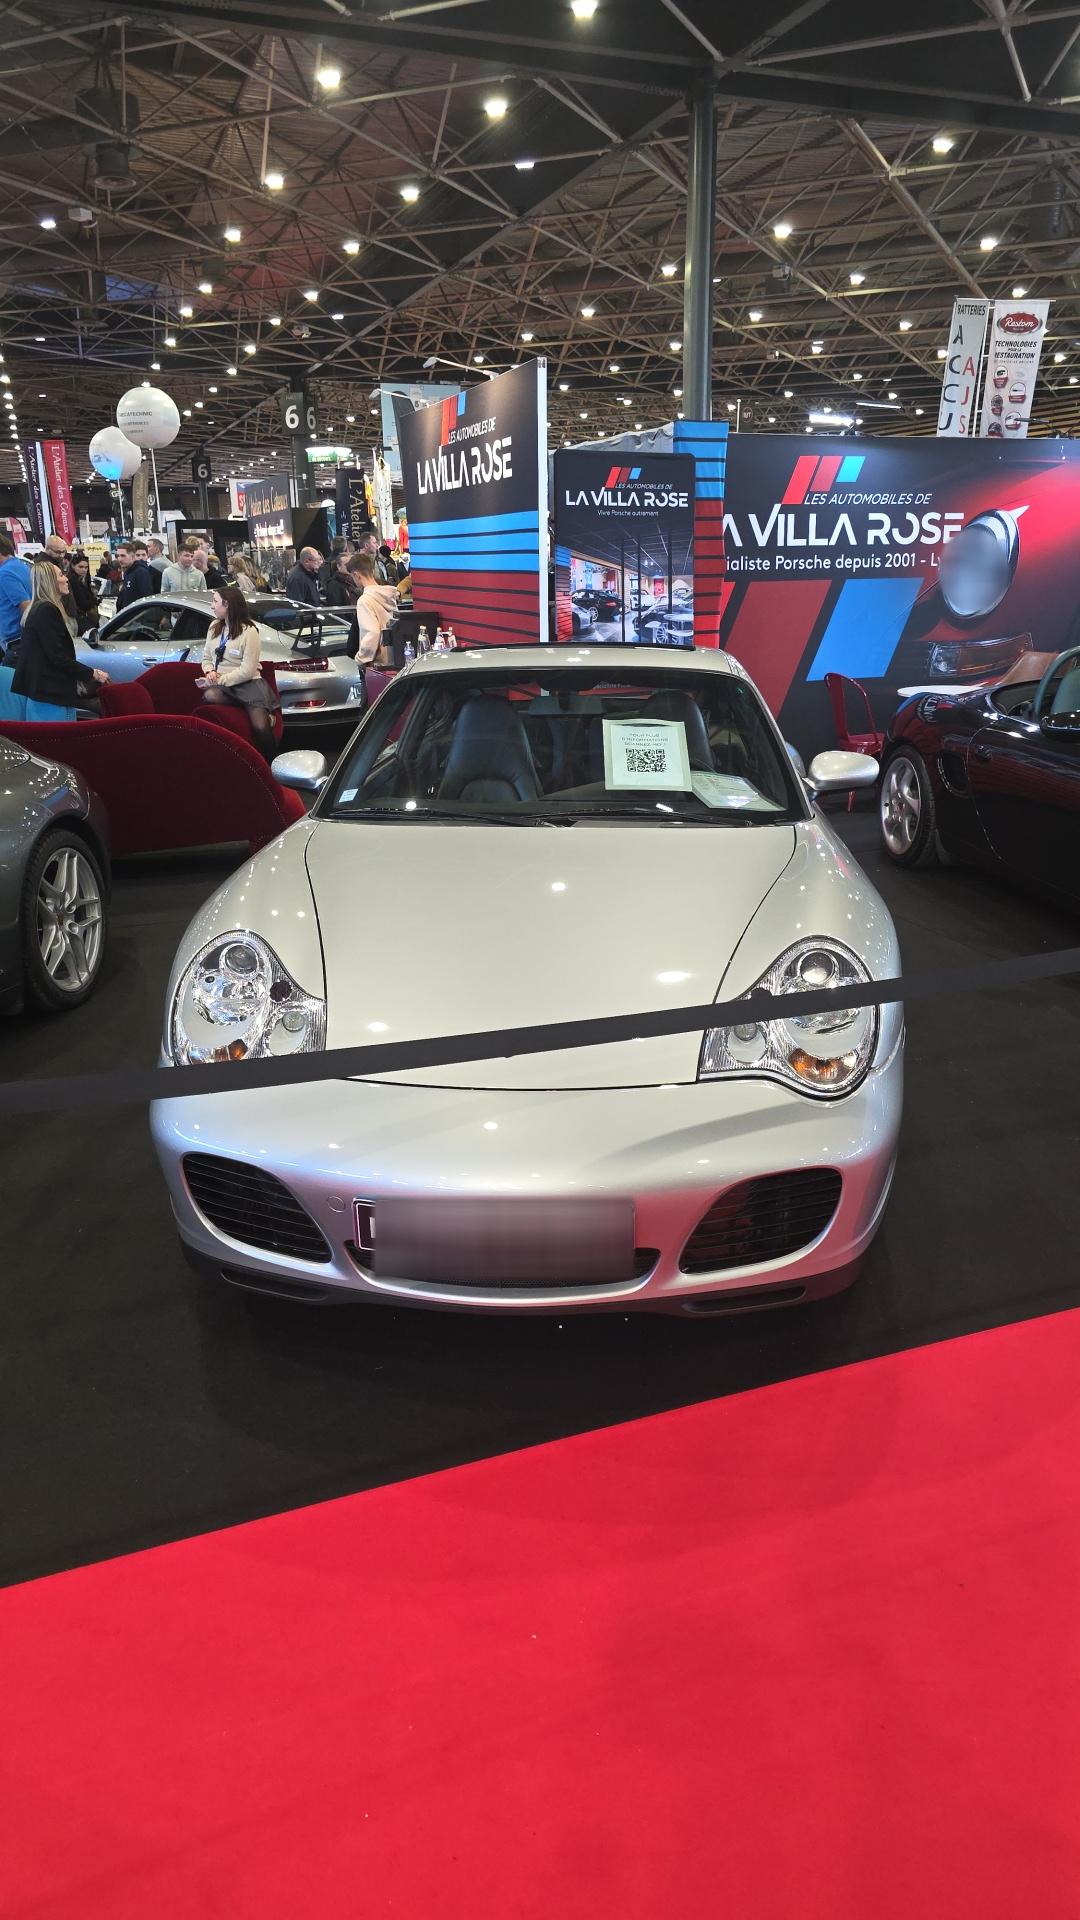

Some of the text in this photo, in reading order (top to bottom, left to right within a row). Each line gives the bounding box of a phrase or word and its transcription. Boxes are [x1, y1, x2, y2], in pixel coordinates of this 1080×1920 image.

[957, 303, 987, 316] BATTERIES
[1004, 316, 1035, 327] Restom
[995, 340, 1038, 348] TECHNOLOGIES
[285, 404, 300, 429] 6
[306, 406, 317, 430] 6
[447, 416, 497, 444] LES AUTOMOBILES DE
[51, 446, 63, 482] L'Atelier
[57, 485, 66, 499] des
[197, 463, 208, 479] 6
[416, 436, 513, 495] LA VILLA ROSE
[565, 486, 689, 508] LA VILLA ROSE
[803, 493, 933, 505] LES AUTOMOBILES DE
[348, 477, 367, 543] L'Atelier
[722, 503, 965, 547] A VILLA ROSE
[726, 555, 771, 571] ialiste
[775, 554, 832, 571] Porsche
[835, 553, 882, 573] depuis
[884, 552, 916, 568] 2001
